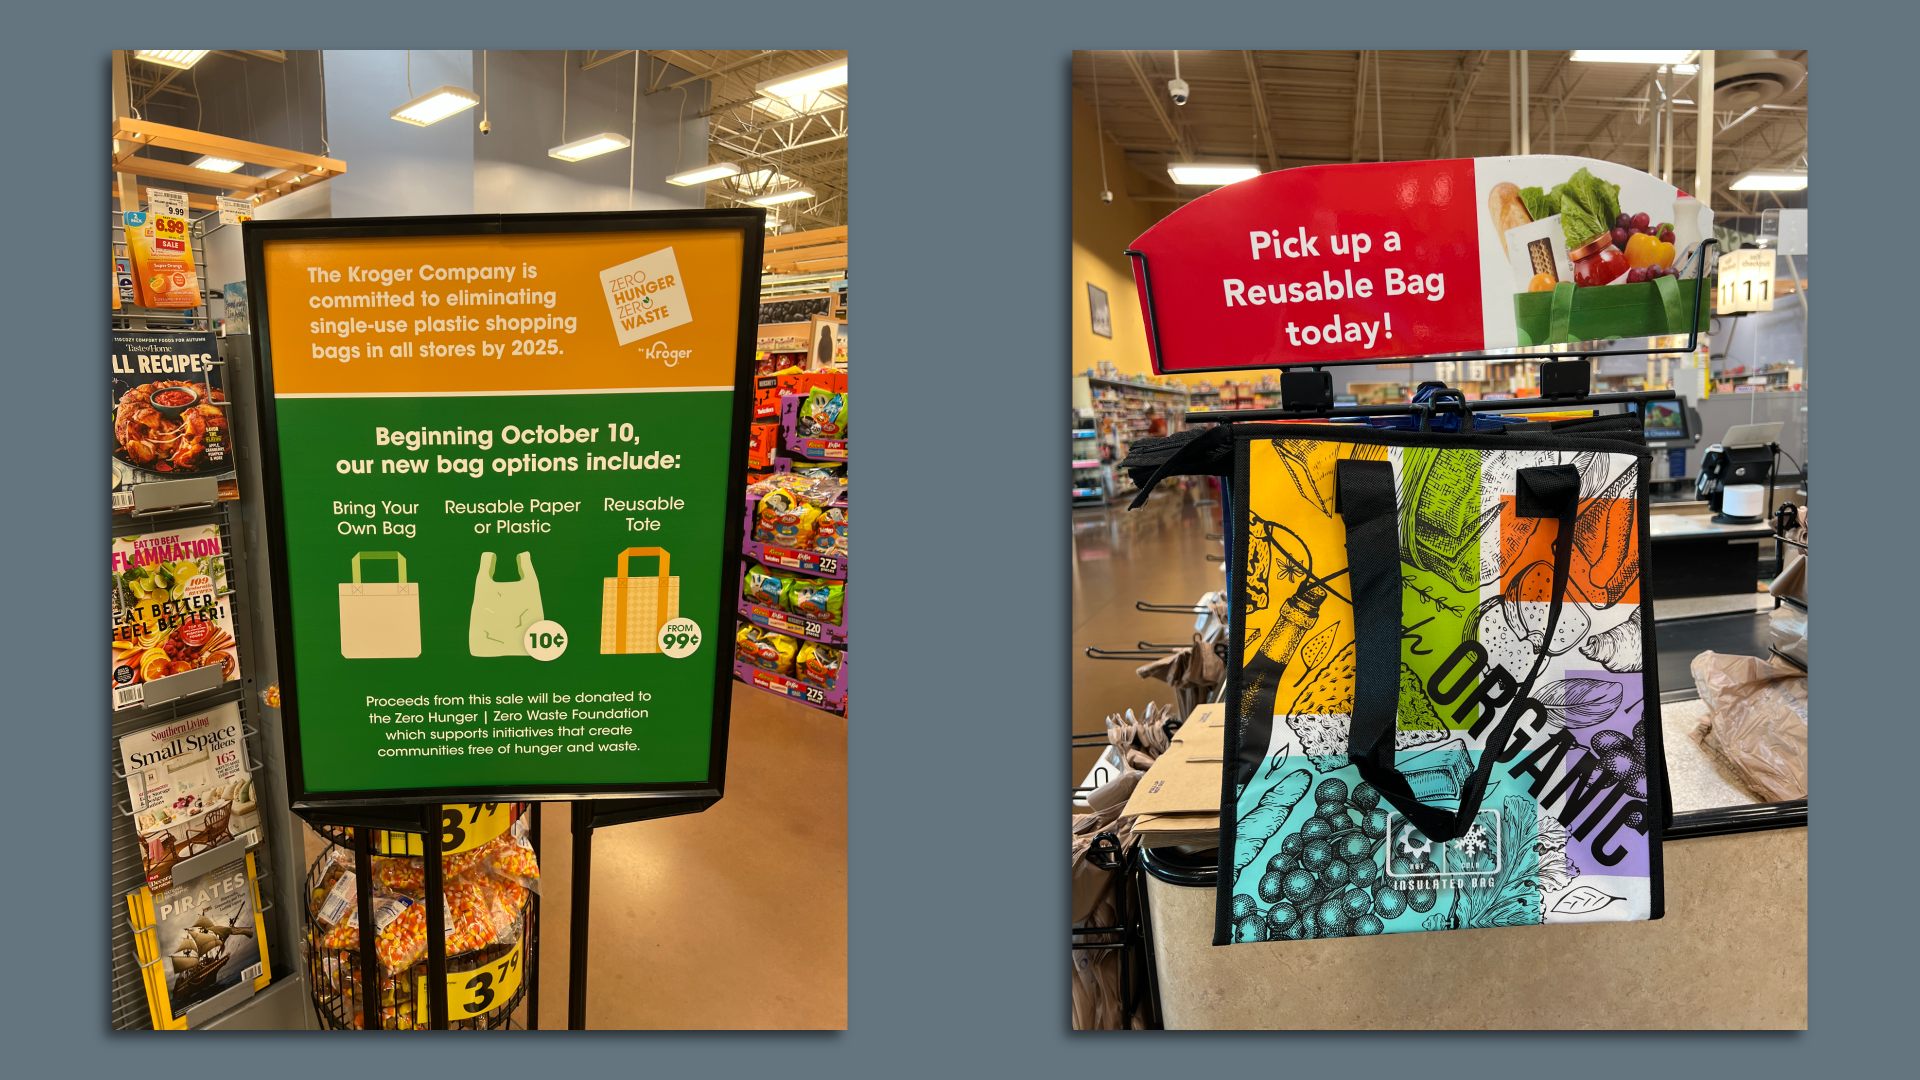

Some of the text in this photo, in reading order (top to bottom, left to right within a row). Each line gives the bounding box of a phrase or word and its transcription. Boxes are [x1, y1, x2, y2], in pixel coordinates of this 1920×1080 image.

[168, 207, 184, 216] 9.99
[156, 218, 184, 234] 6.99
[1250, 227, 1401, 262] Pick up a
[307, 263, 537, 286] The Kroger Company is
[609, 271, 646, 293] ZERO
[614, 275, 676, 305] HUNGER
[1223, 268, 1444, 307] Reusable Bag
[309, 288, 556, 308] committed to eliminating
[617, 298, 653, 319] ZERO
[311, 314, 577, 338] single-use plastic shopping
[621, 306, 669, 331] WASTE
[1285, 312, 1392, 349] today!
[312, 339, 563, 363] bags in all stores by 2025.
[646, 341, 692, 367] Kroger
[112, 353, 213, 373] LL RECIPES
[759, 379, 776, 387] HERSHEY'S
[757, 406, 774, 414] Twizzlers
[376, 423, 639, 451] Beginning October 10,
[336, 451, 680, 478] our new bag options include:
[334, 501, 419, 518] Bring Your
[446, 499, 581, 515] Reusable Paper
[605, 496, 684, 511] Reusable
[338, 521, 415, 538] Own Bag
[475, 520, 550, 533] or Plastic
[626, 518, 660, 531] Tote
[134, 535, 179, 549] EAT TO BEAT
[820, 557, 837, 570] 275
[190, 577, 209, 586] 109
[113, 593, 218, 626] EAT BETTER,
[112, 606, 225, 641] FEEL BETTER!
[667, 624, 693, 633] FROM
[805, 622, 820, 632] 220
[529, 632, 565, 650] 10¢
[662, 633, 699, 651] 99¢
[367, 691, 651, 706] Proceeds from this sale will be donated to
[806, 687, 823, 700] 275
[369, 708, 648, 725] the Zero Hunger Zero Waste Foundation
[151, 721, 186, 742] Southern
[186, 716, 209, 731] Living
[386, 725, 632, 741] which supports initiatives that create
[130, 738, 182, 770] Small
[187, 725, 236, 752] Space
[211, 737, 236, 752] Ideas
[378, 741, 639, 756] communities free of hunger and waste.
[1427, 639, 1649, 867] ORGANIC
[216, 750, 236, 766] 165
[1394, 878, 1495, 890] INSULATED BAG
[160, 872, 245, 921] PIRATES
